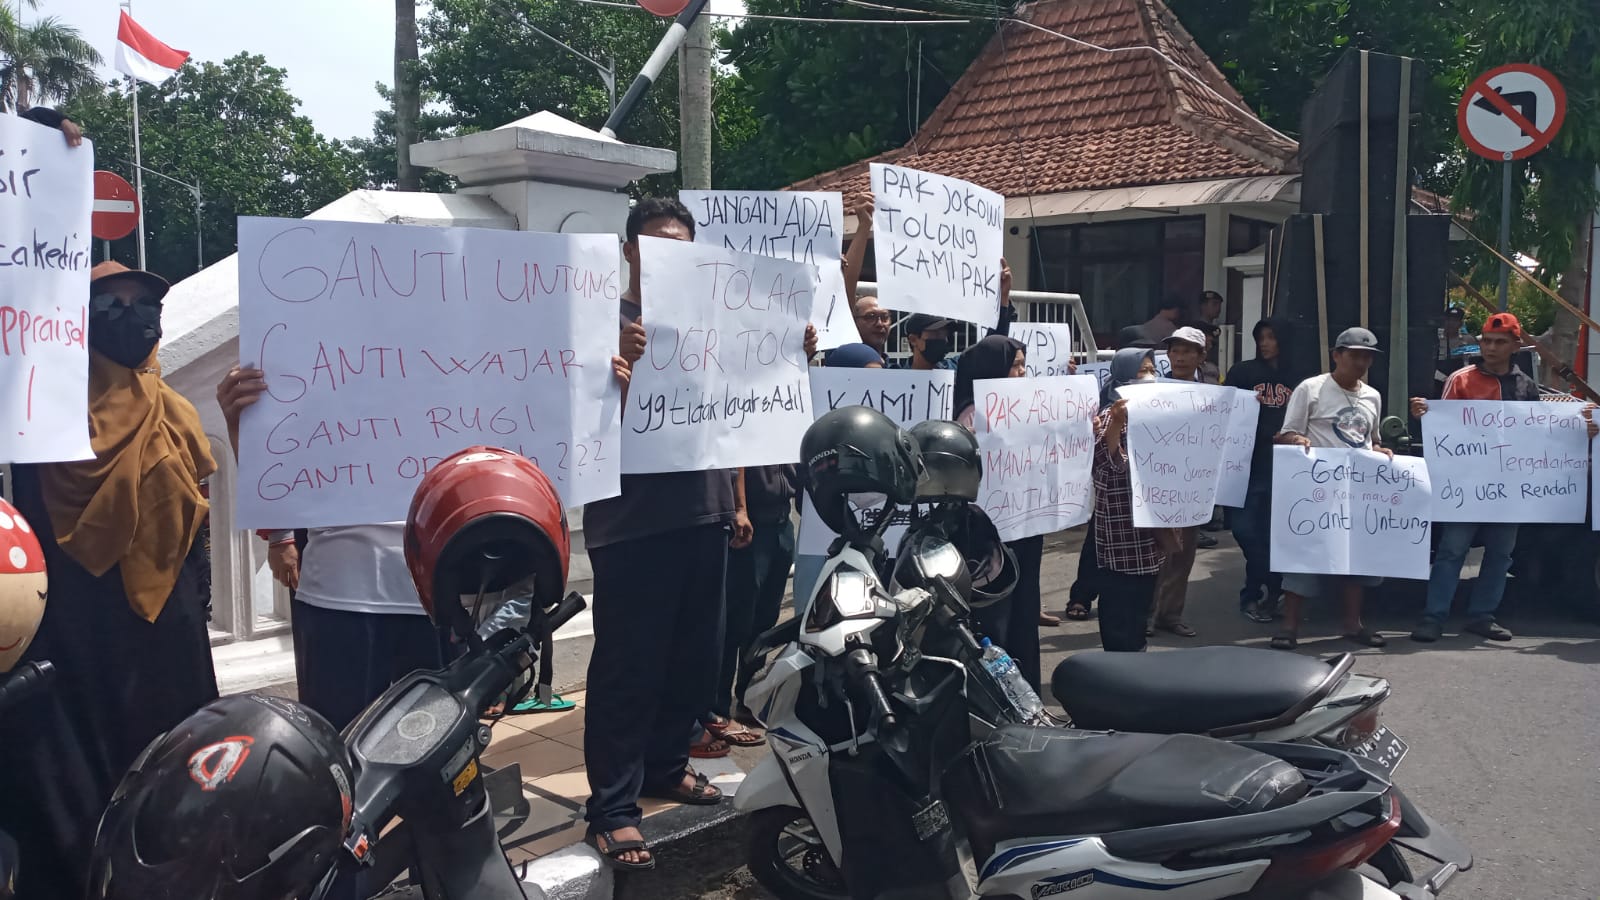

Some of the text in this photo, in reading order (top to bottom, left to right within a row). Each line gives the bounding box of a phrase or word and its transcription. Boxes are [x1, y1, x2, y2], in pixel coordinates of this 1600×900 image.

[883, 167, 935, 204] PAK
[698, 194, 834, 239] JANGAN ADA
[258, 226, 619, 303] GANTI UNTUNG
[890, 242, 996, 299] KAMI PAK
[696, 260, 809, 321] TOLAK
[260, 322, 585, 403] GANTI WAJAR
[651, 326, 801, 374] UGR TOL
[18, 364, 35, 435] !
[632, 392, 666, 434] yg
[669, 387, 720, 426] tidak
[985, 391, 1021, 434] PAK
[1026, 388, 1060, 425] ABU
[1462, 406, 1582, 434] Masa depan
[265, 404, 536, 455] GANTI RUGI
[1142, 422, 1205, 447] Wakil
[1433, 434, 1488, 458] Kami
[257, 461, 375, 501] GANTI
[555, 439, 606, 481] ???
[808, 448, 838, 467] HONDA
[985, 445, 1033, 490] MANA
[1134, 449, 1177, 476] Mana
[1311, 458, 1417, 492] Ganti Rugi
[983, 487, 1042, 521] GANTI
[1440, 475, 1577, 509] dg UGR Rendah
[1365, 503, 1430, 545] Untung
